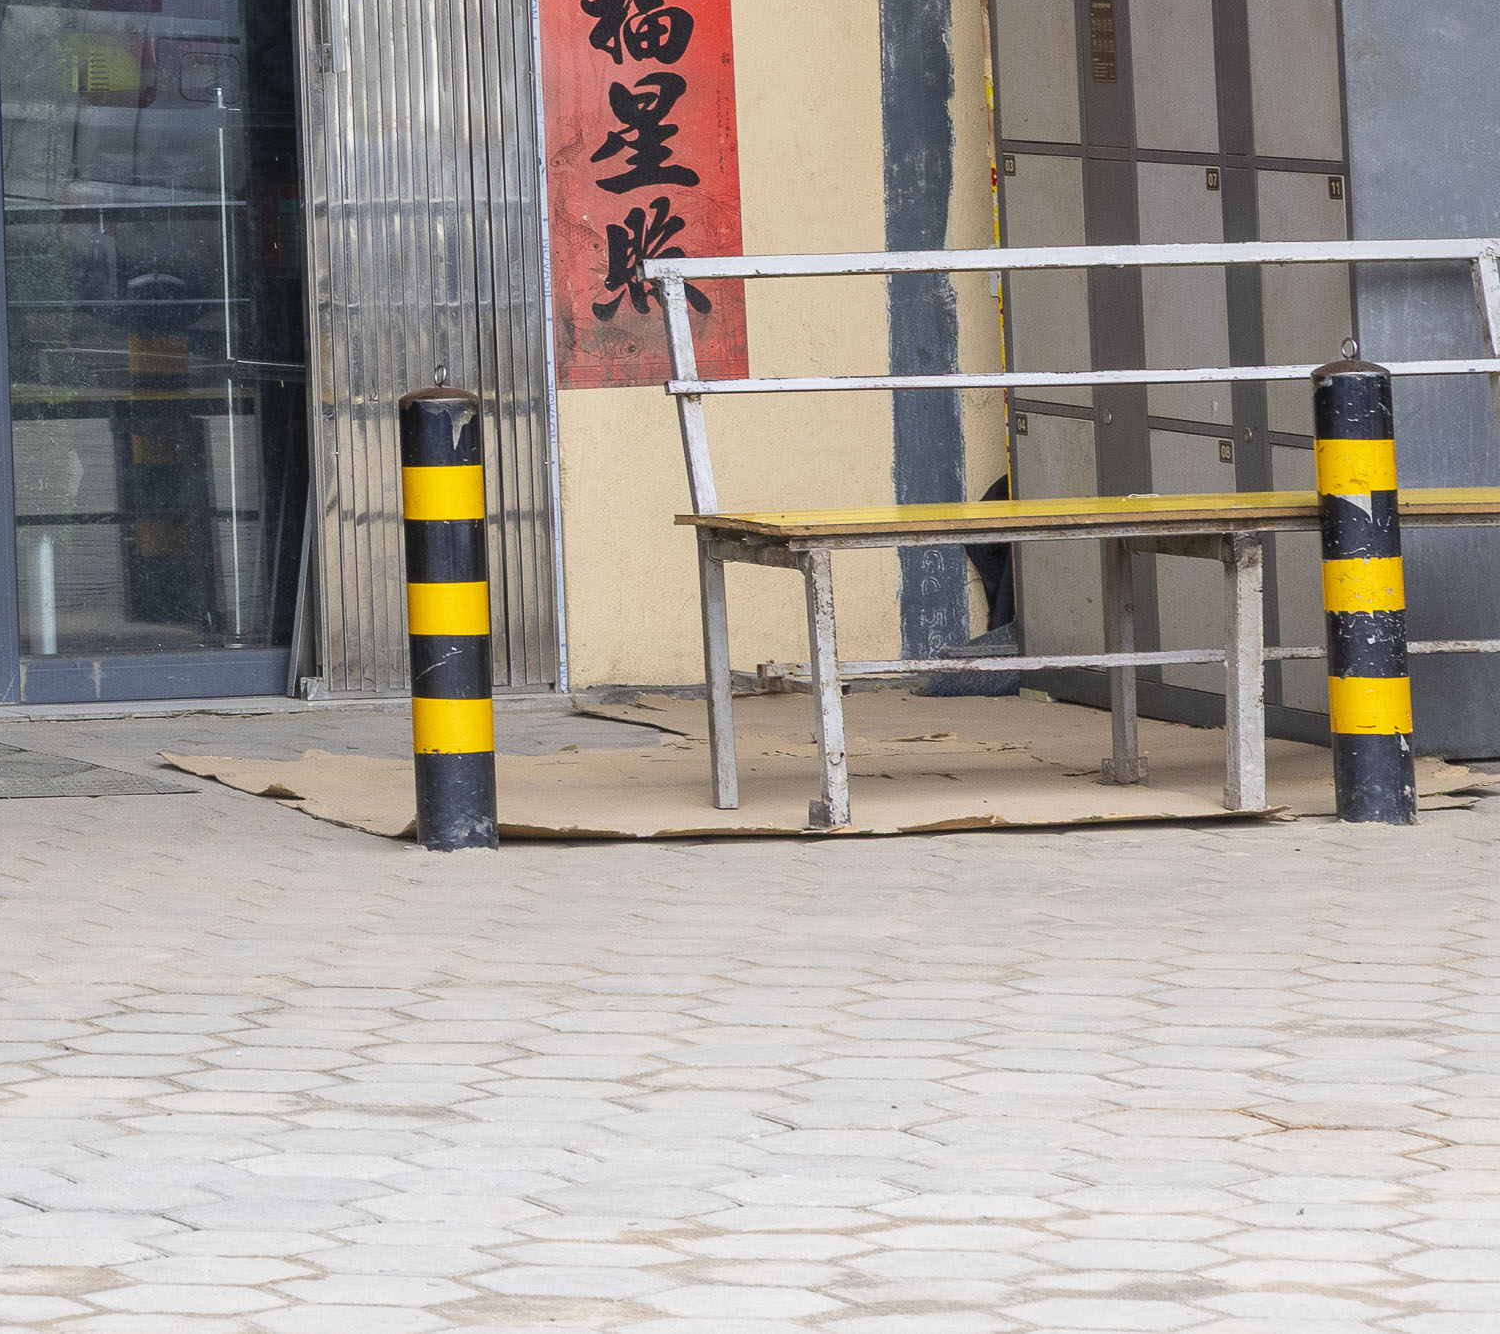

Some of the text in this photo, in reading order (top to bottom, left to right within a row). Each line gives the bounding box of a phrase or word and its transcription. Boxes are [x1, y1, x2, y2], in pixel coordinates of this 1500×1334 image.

[1004, 159, 1014, 174] 03
[1208, 173, 1218, 187] 07
[1331, 182, 1341, 196] 11
[1016, 419, 1027, 433] 04
[1220, 444, 1231, 459] 08
